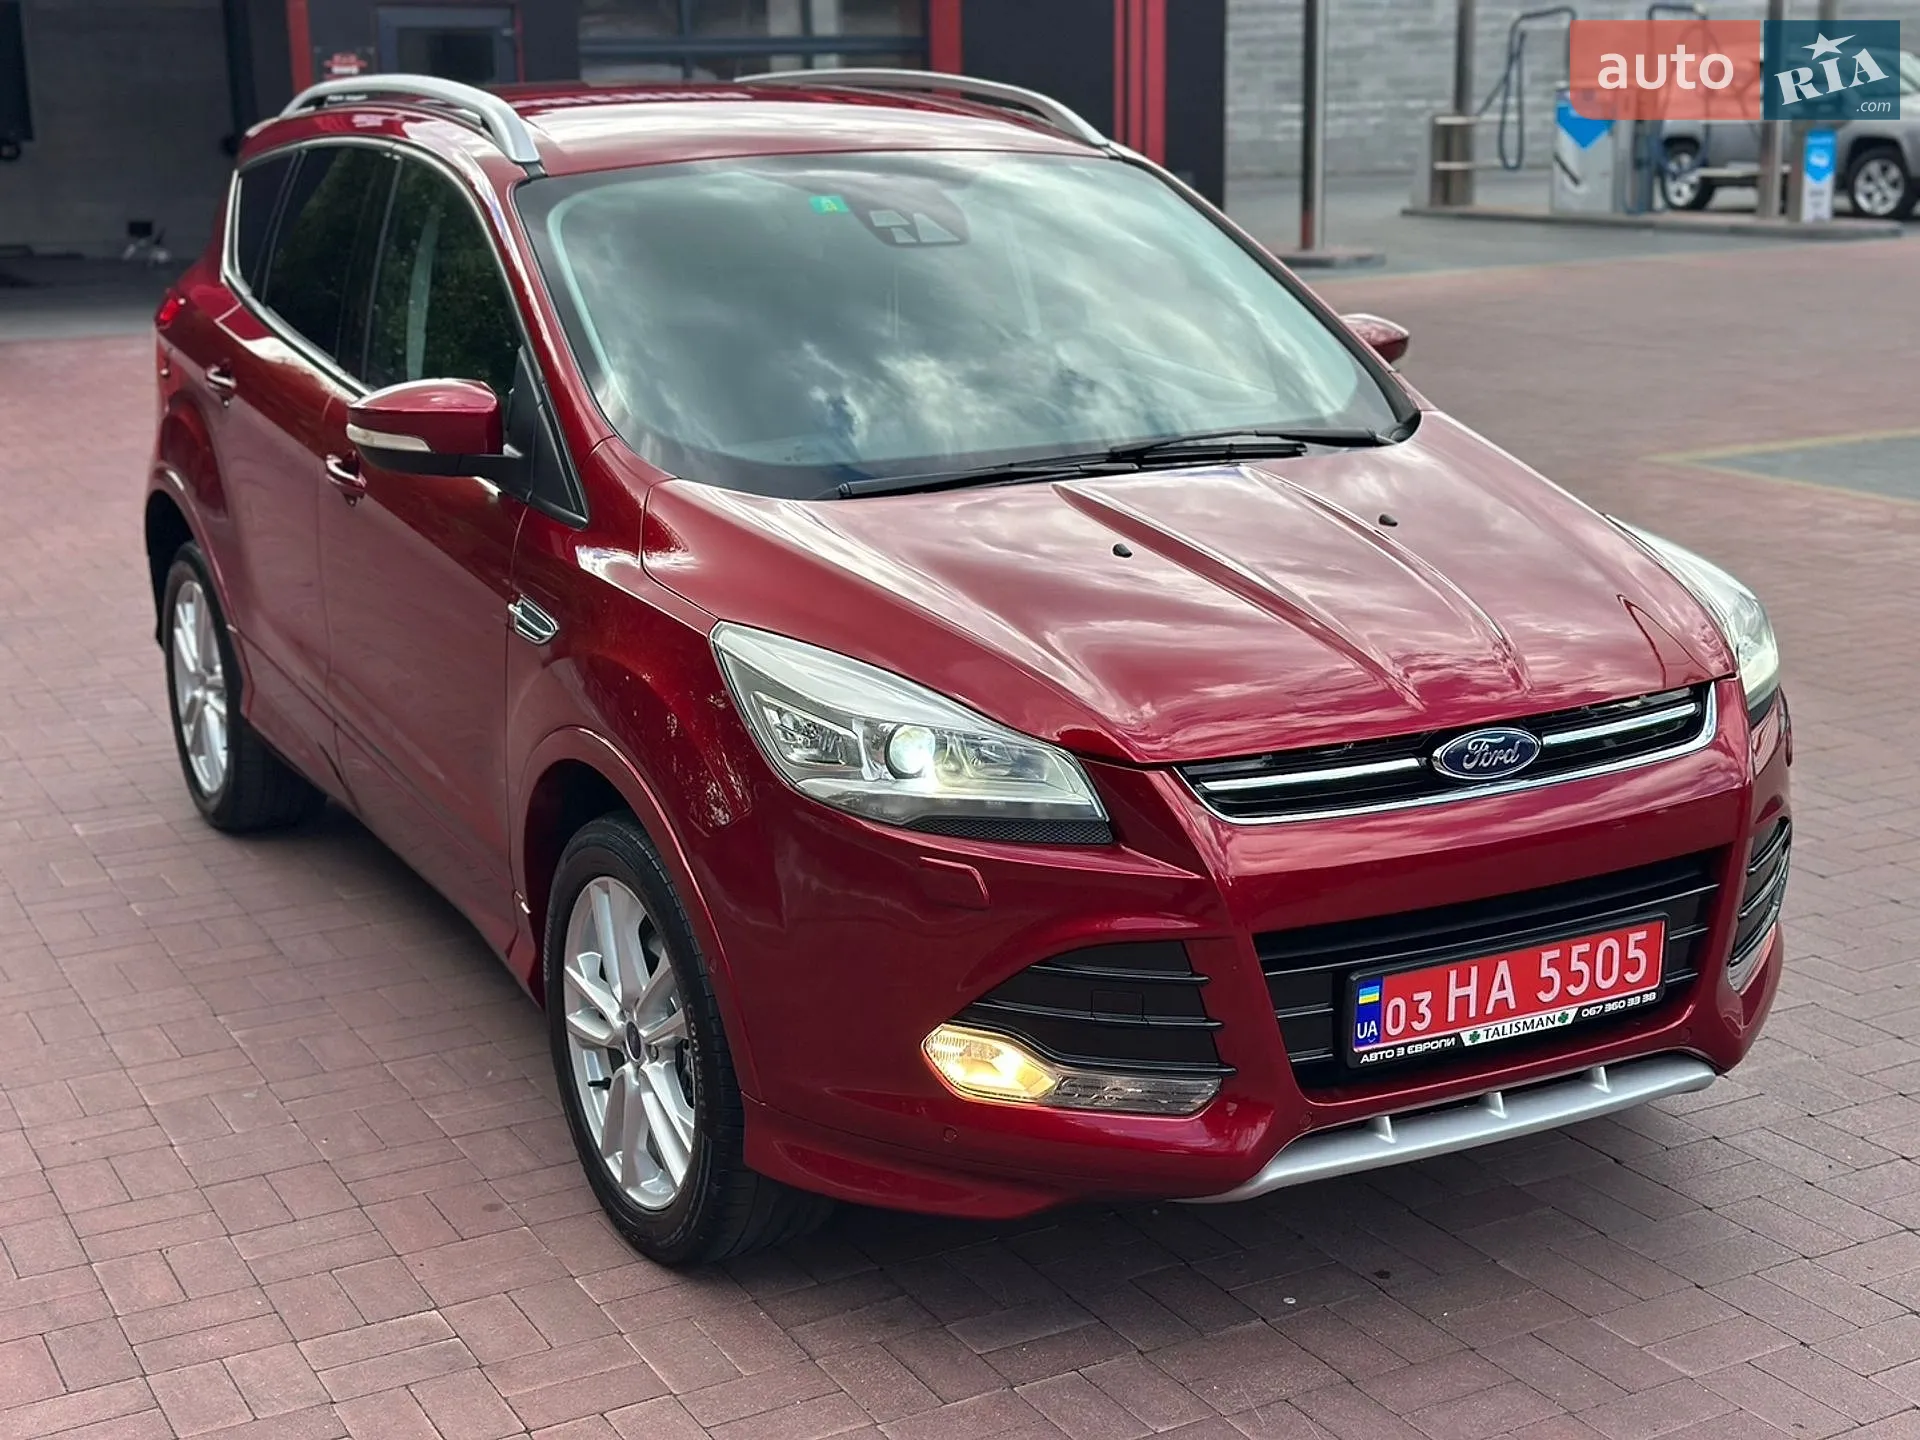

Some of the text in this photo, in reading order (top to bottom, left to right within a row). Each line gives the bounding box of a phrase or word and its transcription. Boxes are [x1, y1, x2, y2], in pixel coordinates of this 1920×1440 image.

[1462, 735, 1521, 770] Ford
[1385, 930, 1648, 1037] 03 HA 5505
[1581, 1005, 1603, 1018] 067
[1356, 1021, 1378, 1039] UA
[1483, 1015, 1556, 1040] TALISMAN
[1360, 1049, 1395, 1064] АВТО
